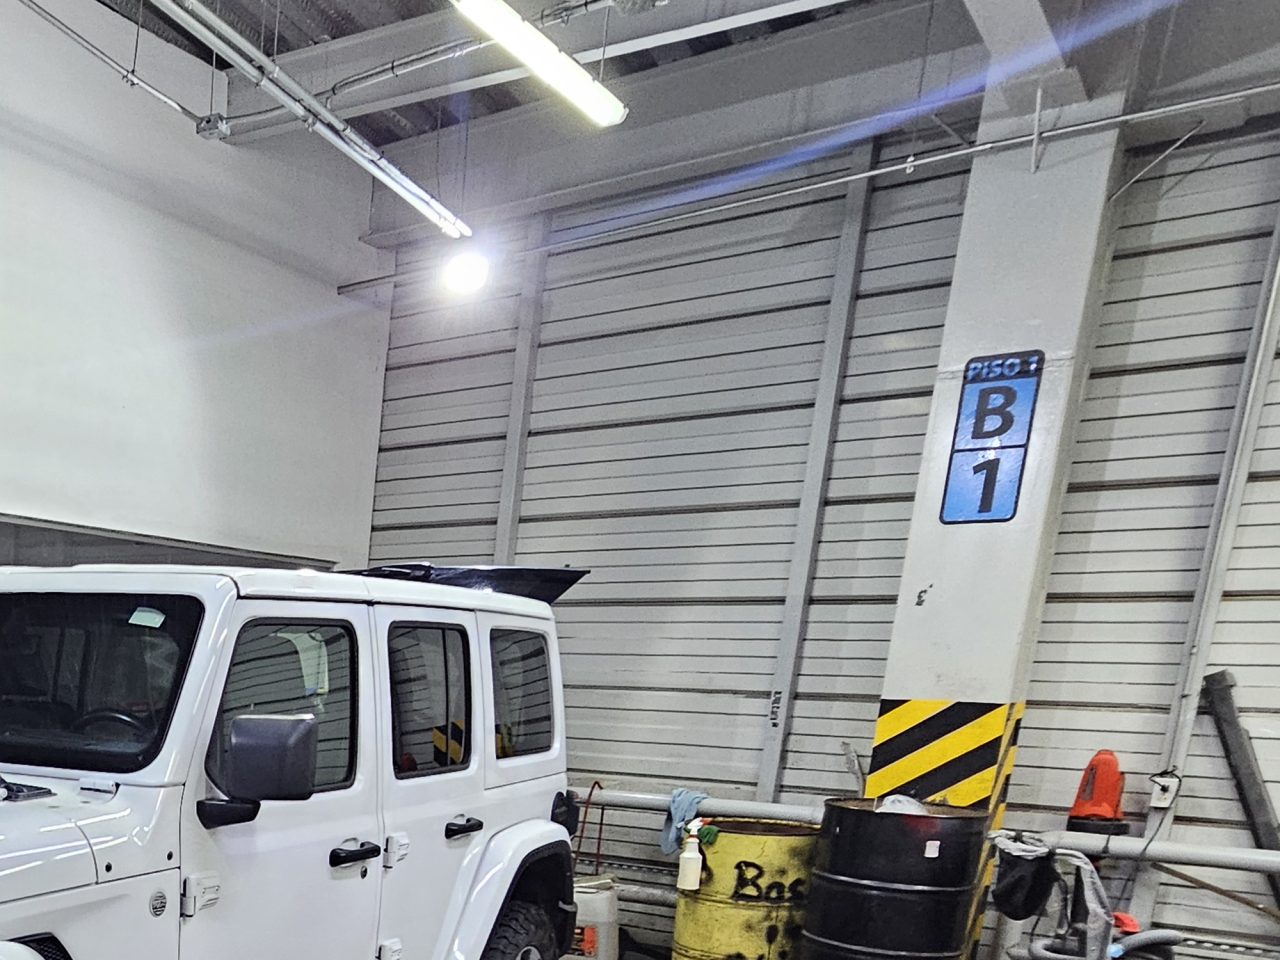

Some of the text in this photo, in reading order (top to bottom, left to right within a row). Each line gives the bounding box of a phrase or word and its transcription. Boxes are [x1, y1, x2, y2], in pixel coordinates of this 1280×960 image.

[966, 355, 1039, 380] PISO 1
[971, 385, 1018, 440] B
[972, 457, 1001, 514] 1
